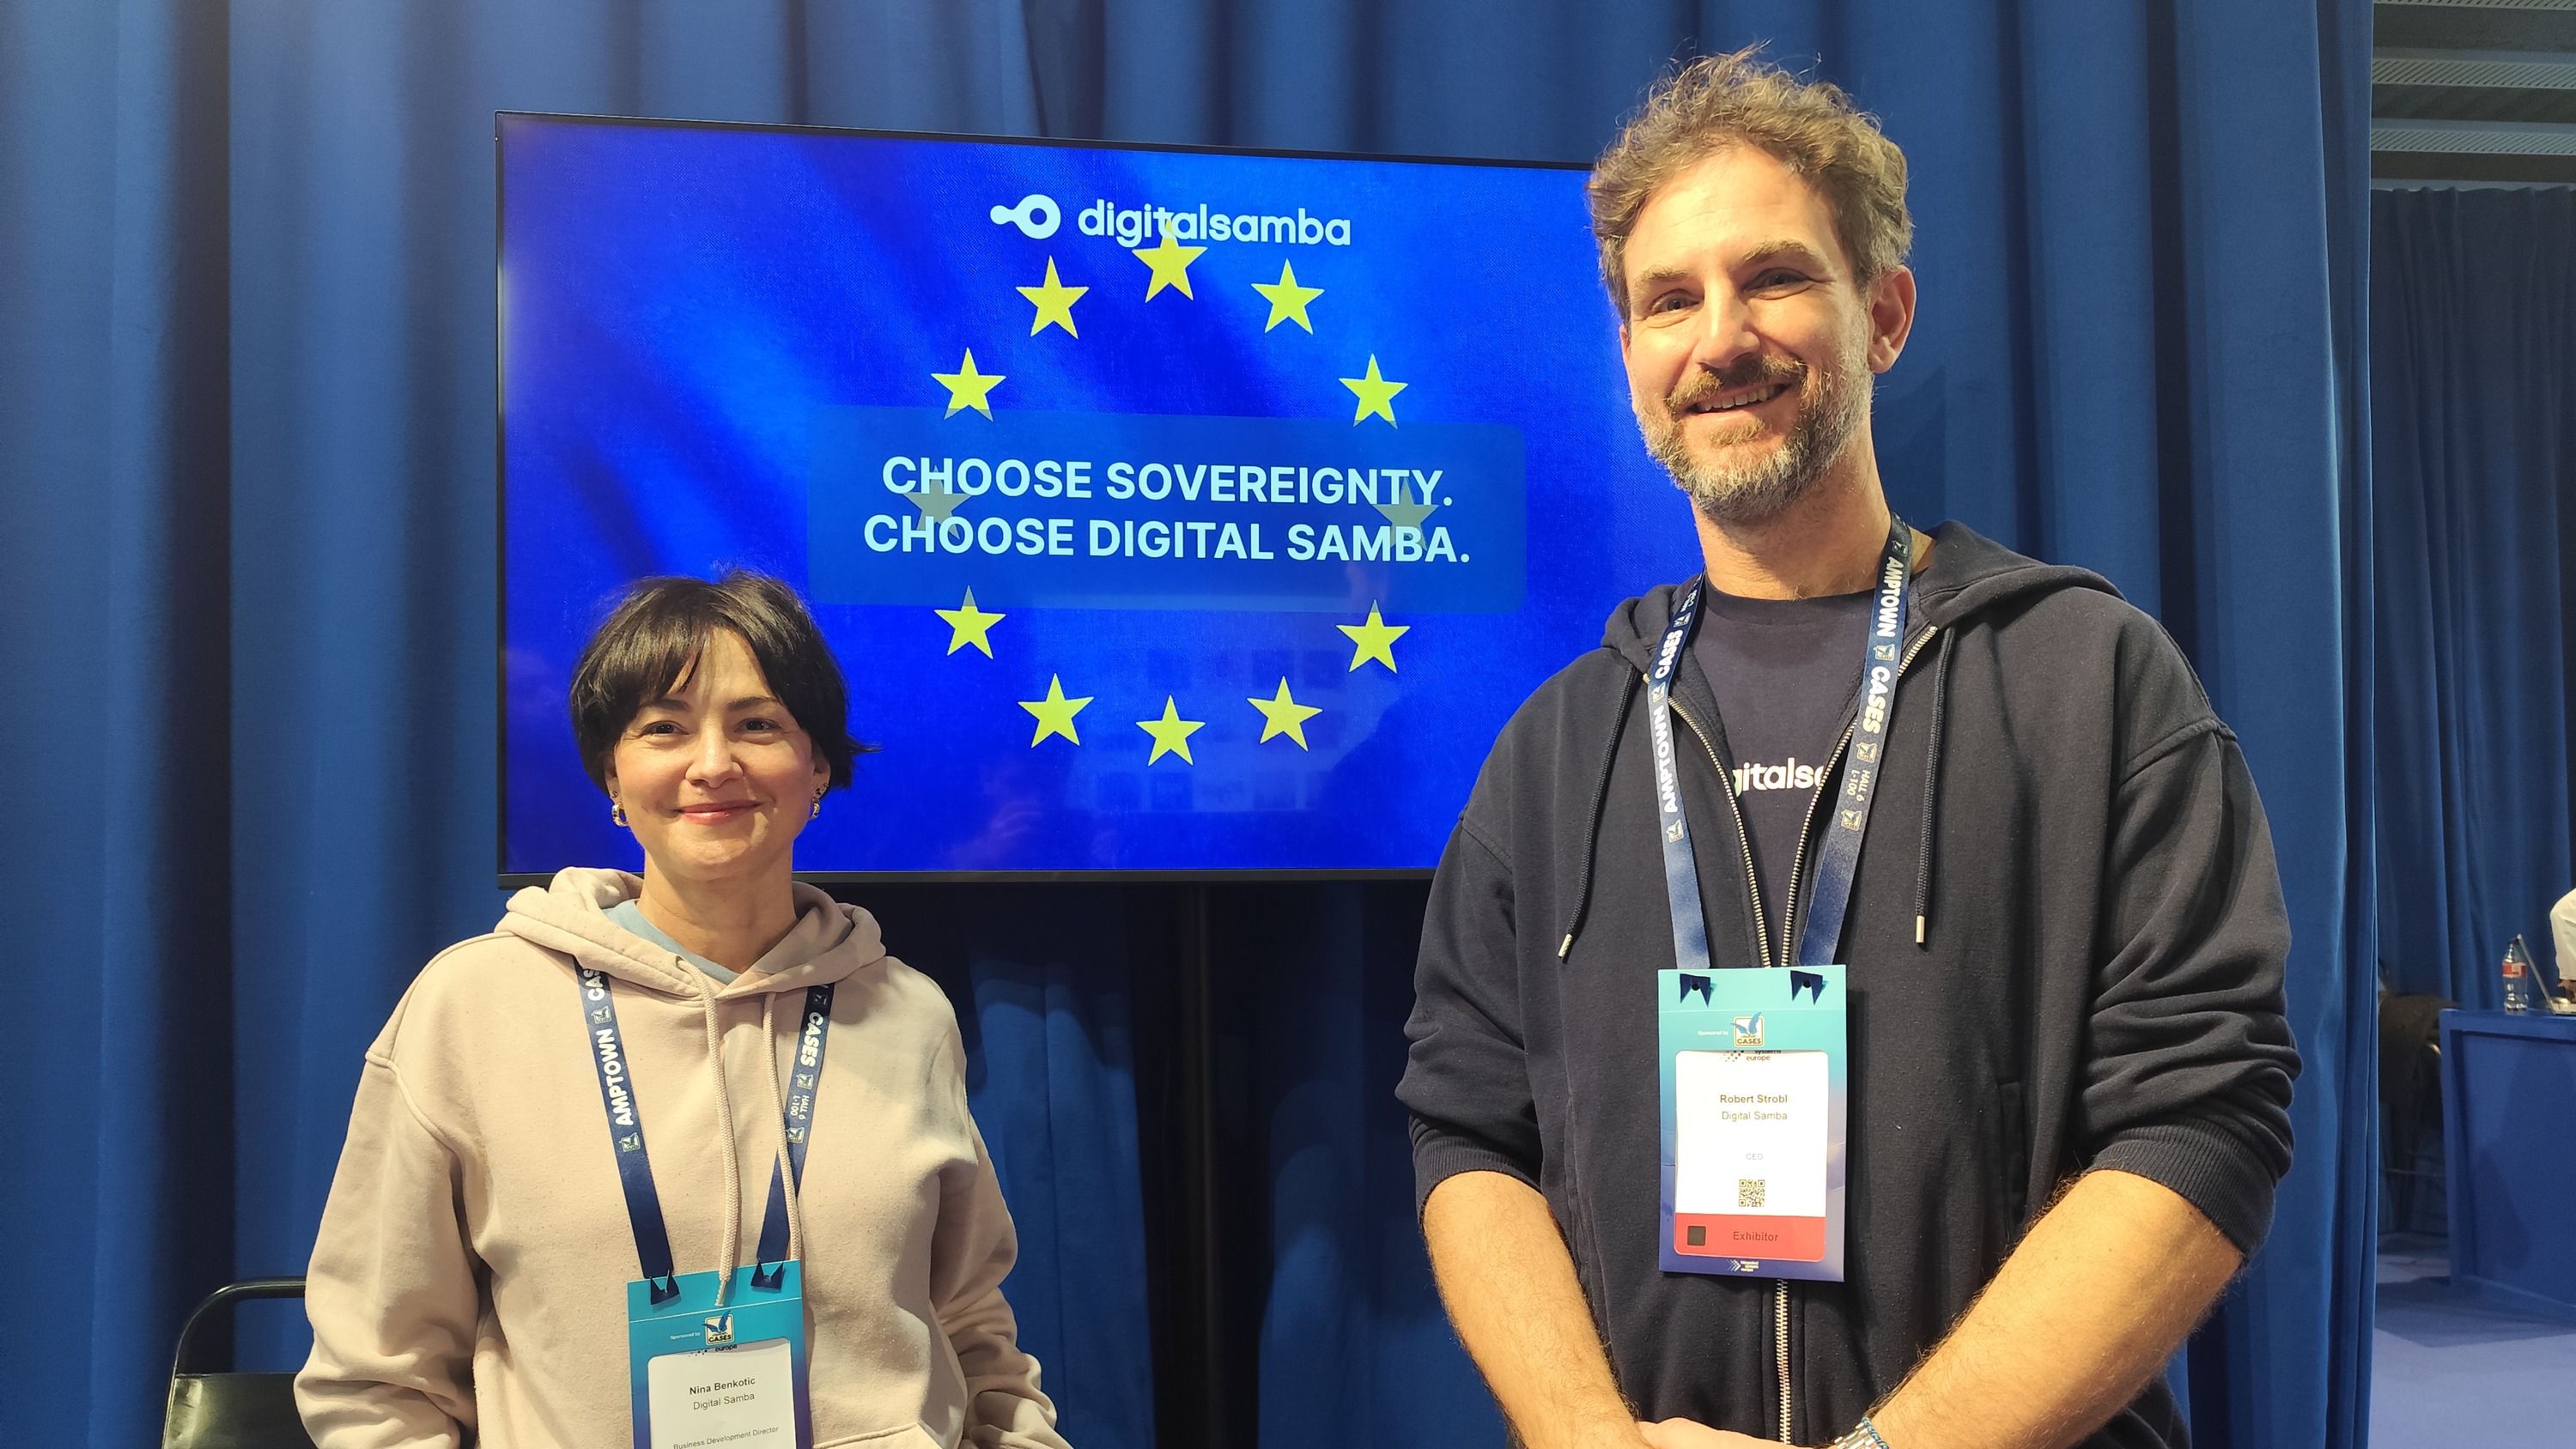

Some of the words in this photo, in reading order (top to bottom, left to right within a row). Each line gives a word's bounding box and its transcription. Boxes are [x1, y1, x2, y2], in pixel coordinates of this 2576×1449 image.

[1078, 199, 1352, 248] digitalsamba
[882, 455, 1092, 500] CHOOSE
[1106, 462, 1454, 507] SOVEREIGNTY.
[863, 514, 1074, 557] CHOOSE
[1089, 518, 1279, 562] DIGITAL
[1287, 522, 1471, 564] SAMBA.
[1876, 556, 1905, 637] AMPTOWN
[1655, 629, 1683, 679] CASES
[1862, 666, 1891, 734] CASES
[1654, 704, 1678, 813] AMPTOWN
[1858, 770, 1871, 792] HALL
[583, 969, 605, 1001] CAS
[800, 1012, 823, 1068] CASES
[598, 1028, 634, 1126] AMPTOWN
[1720, 1094, 1754, 1104] Robert
[1757, 1094, 1788, 1104] Strobl
[1722, 1110, 1752, 1123] Digital
[1754, 1111, 1788, 1121] Samba
[1733, 1230, 1779, 1242] Exhibitor
[708, 1334, 732, 1343] CASES
[690, 1385, 712, 1395] Nina
[714, 1376, 756, 1391] Benkotic
[693, 1398, 721, 1410] Digital
[724, 1392, 755, 1404] Samba
[673, 1440, 705, 1449] Business
[706, 1431, 751, 1445] Development
[752, 1426, 779, 1436] Director
